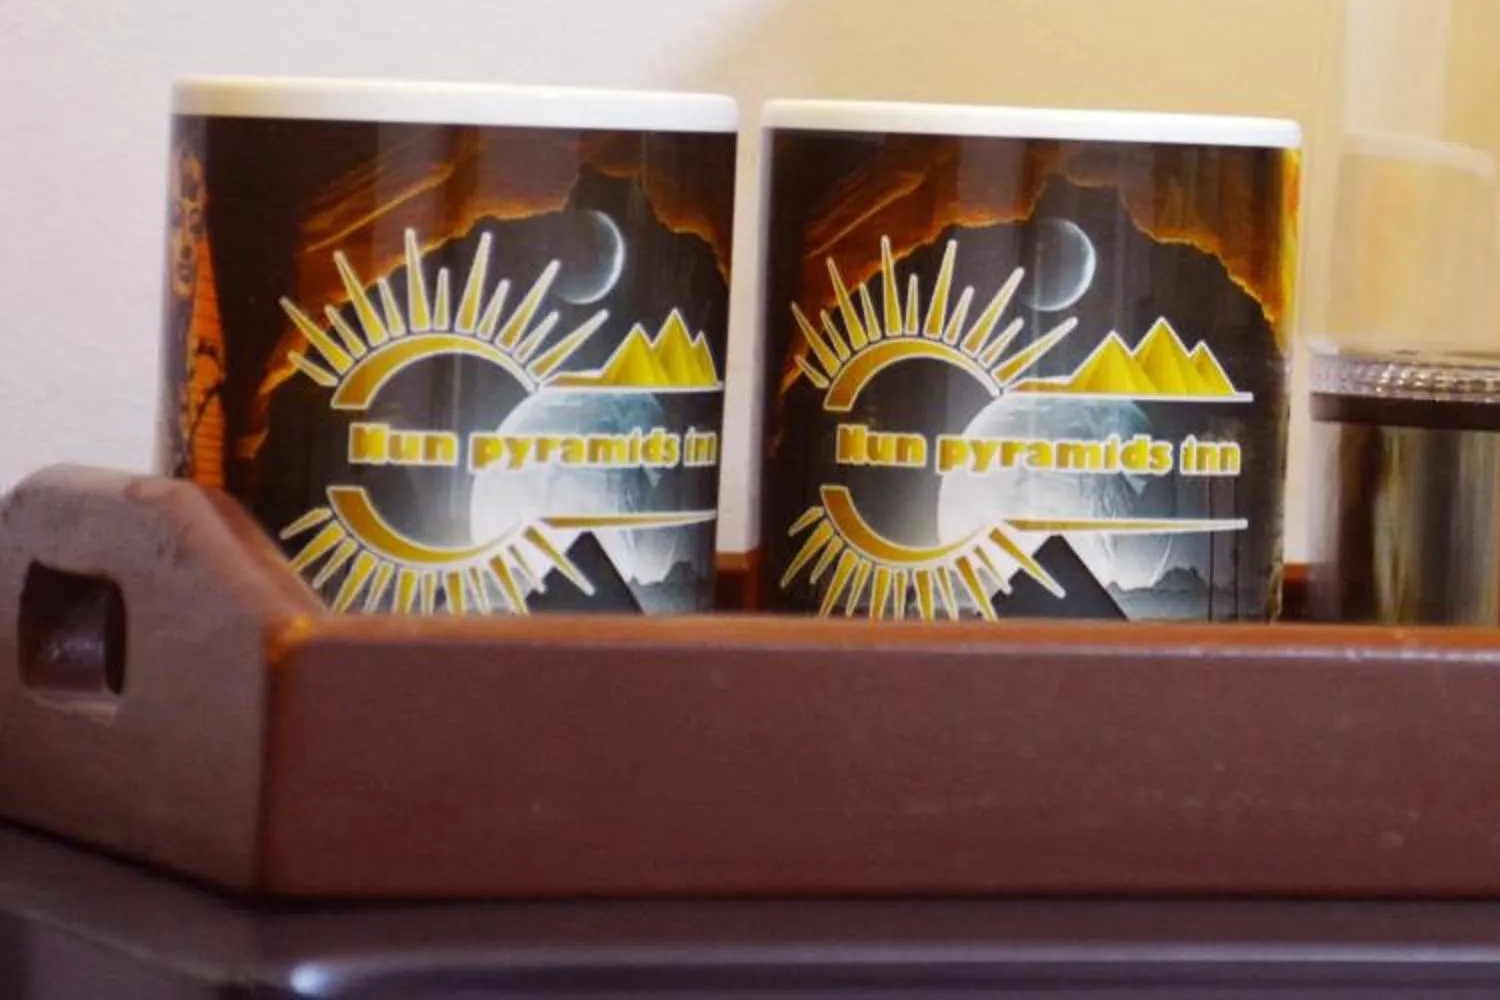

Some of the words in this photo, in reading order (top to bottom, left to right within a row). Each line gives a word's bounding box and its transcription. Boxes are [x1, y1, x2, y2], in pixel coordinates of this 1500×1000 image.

[467, 426, 680, 475] pyramids
[935, 433, 1173, 475] pyramids
[1179, 433, 1241, 476] inn
